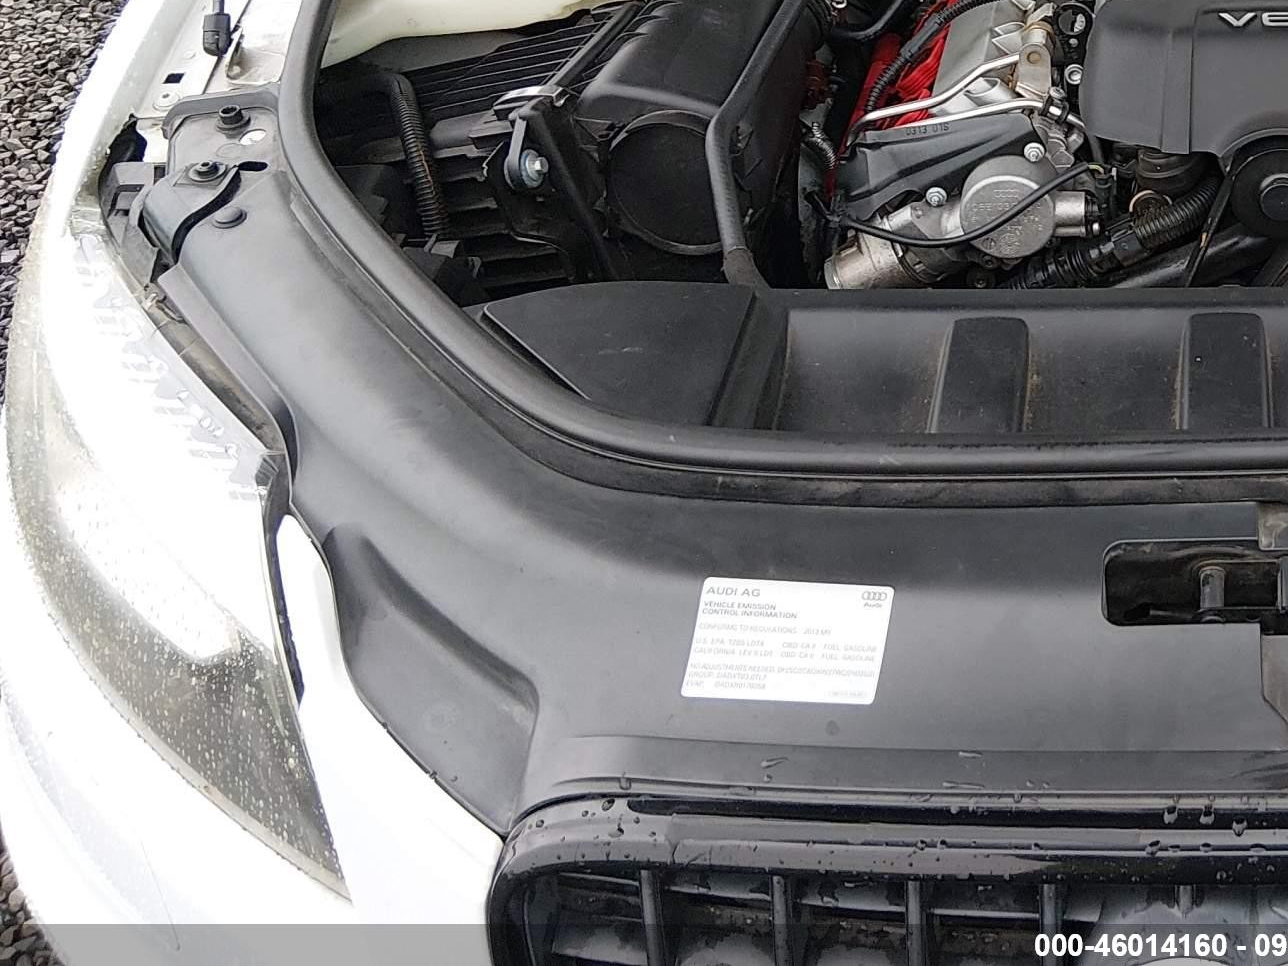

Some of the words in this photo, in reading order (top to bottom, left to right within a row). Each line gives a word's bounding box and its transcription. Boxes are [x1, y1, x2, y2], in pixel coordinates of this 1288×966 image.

[705, 587, 738, 597] AUDI
[740, 588, 761, 598] AG
[703, 601, 735, 609] VEHICLE
[737, 602, 777, 611] EMISSION
[702, 608, 739, 616] CONTROL
[741, 610, 798, 619] INFORMATION
